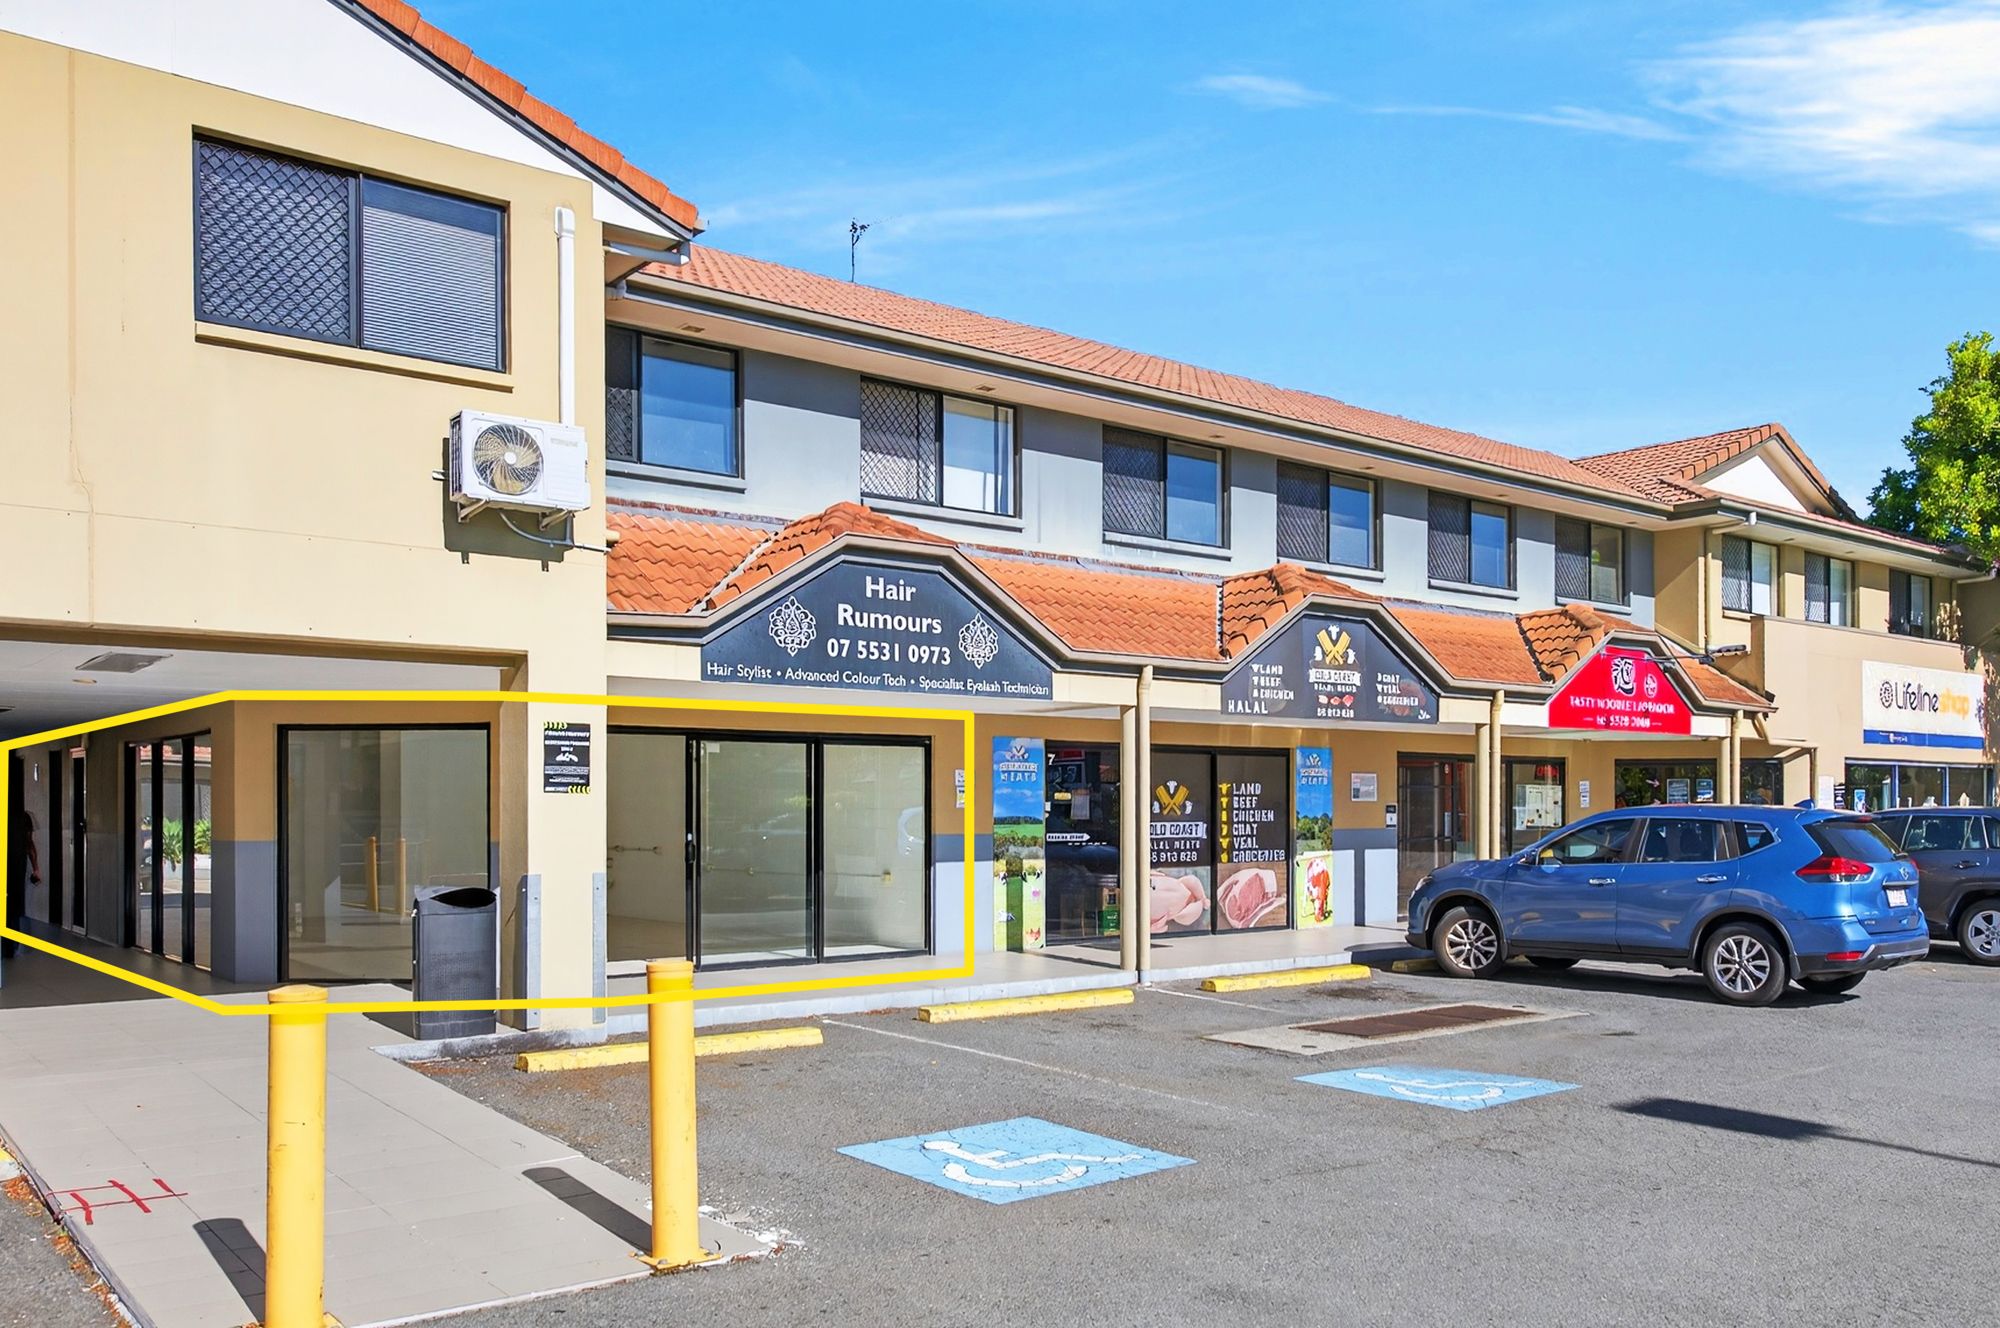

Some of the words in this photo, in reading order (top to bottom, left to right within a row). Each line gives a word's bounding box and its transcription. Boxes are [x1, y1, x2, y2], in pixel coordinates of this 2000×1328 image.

[865, 575, 917, 602] Hair
[837, 603, 942, 634] Rumours
[827, 637, 850, 658] 07
[857, 640, 900, 662] 5531
[907, 644, 951, 665] 0973
[706, 661, 734, 677] Hair
[736, 664, 772, 681] Stylist
[784, 667, 840, 683] Advanced
[842, 670, 882, 687] Colour
[882, 673, 906, 687] Tech
[1228, 700, 1269, 714] HALAL
[1894, 681, 1939, 713] Lifeline
[1047, 753, 1056, 766] 7
[1150, 824, 1167, 836] OLD
